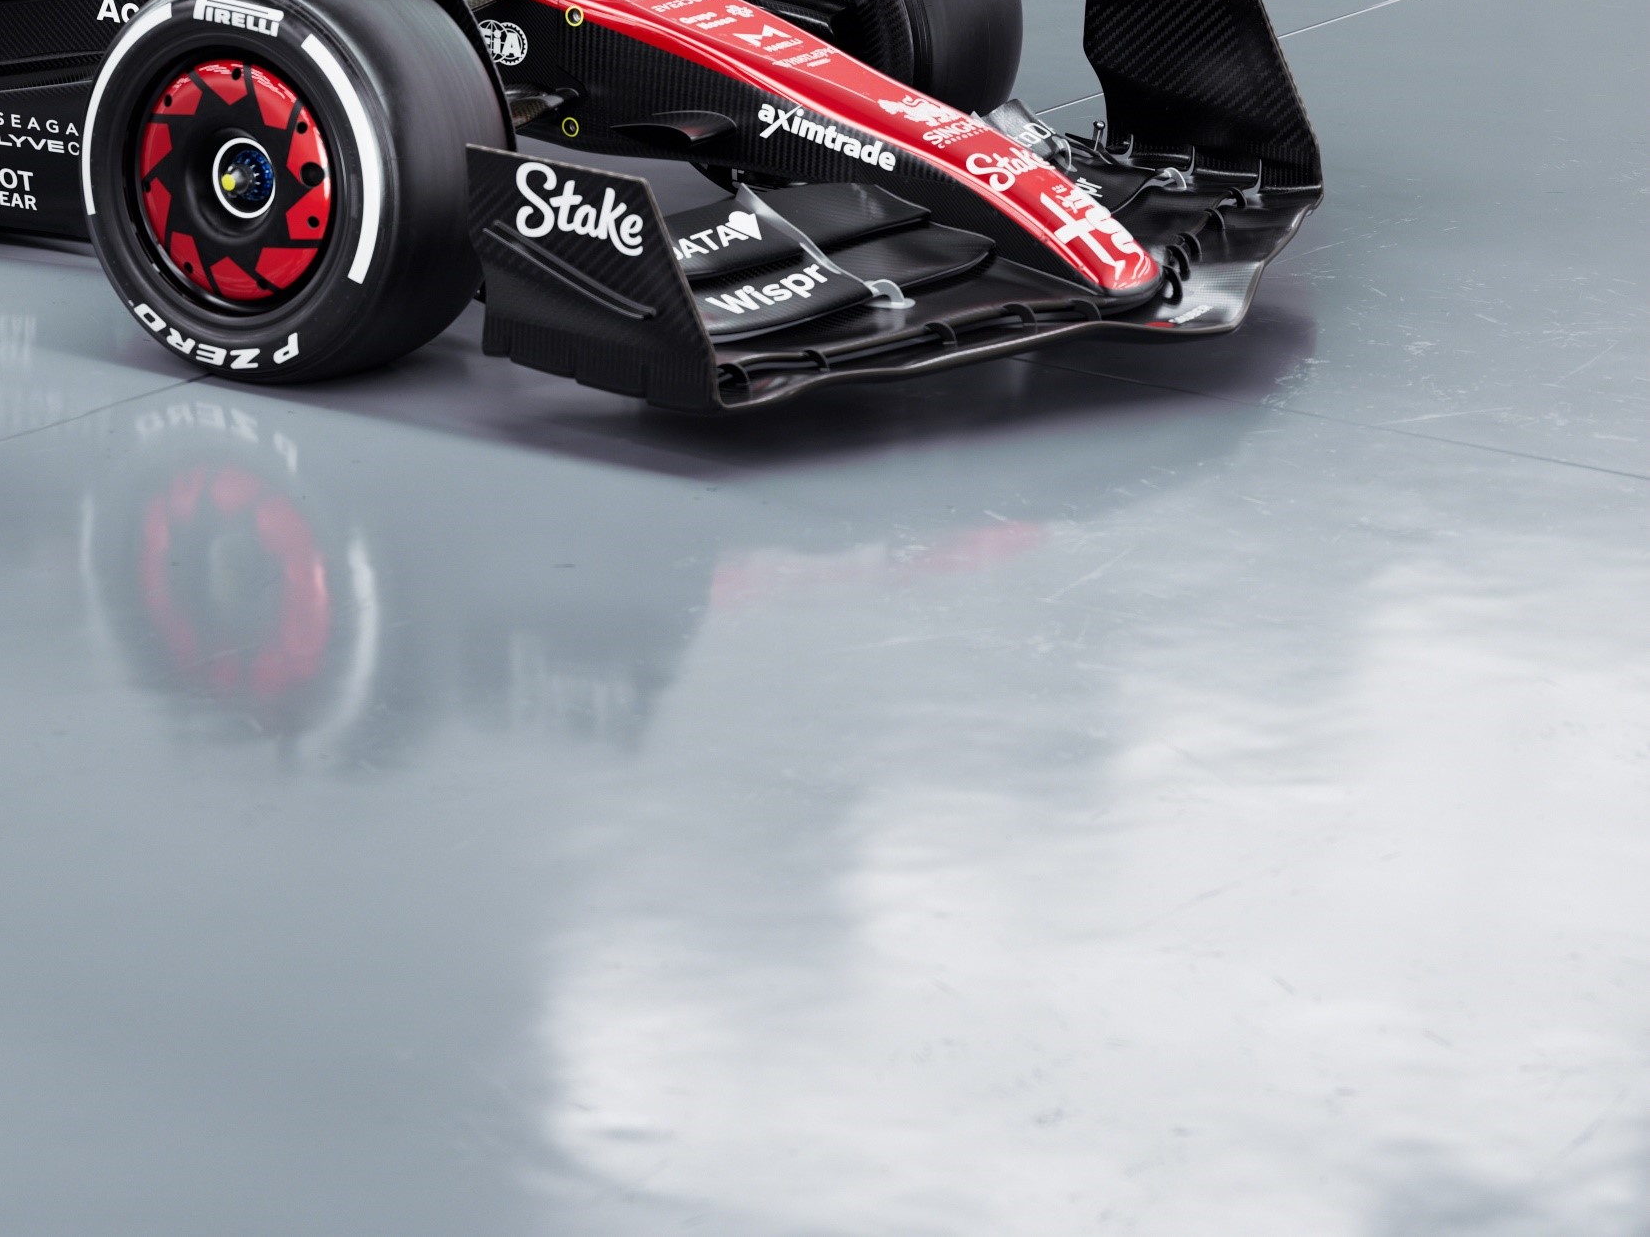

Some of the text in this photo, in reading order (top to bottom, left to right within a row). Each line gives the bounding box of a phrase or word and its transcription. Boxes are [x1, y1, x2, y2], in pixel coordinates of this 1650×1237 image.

[758, 103, 896, 171] aximtrade
[966, 147, 1056, 192] Stake
[515, 162, 643, 256] Stake
[705, 263, 828, 315] Wispr
[134, 303, 299, 370] P ZERO
